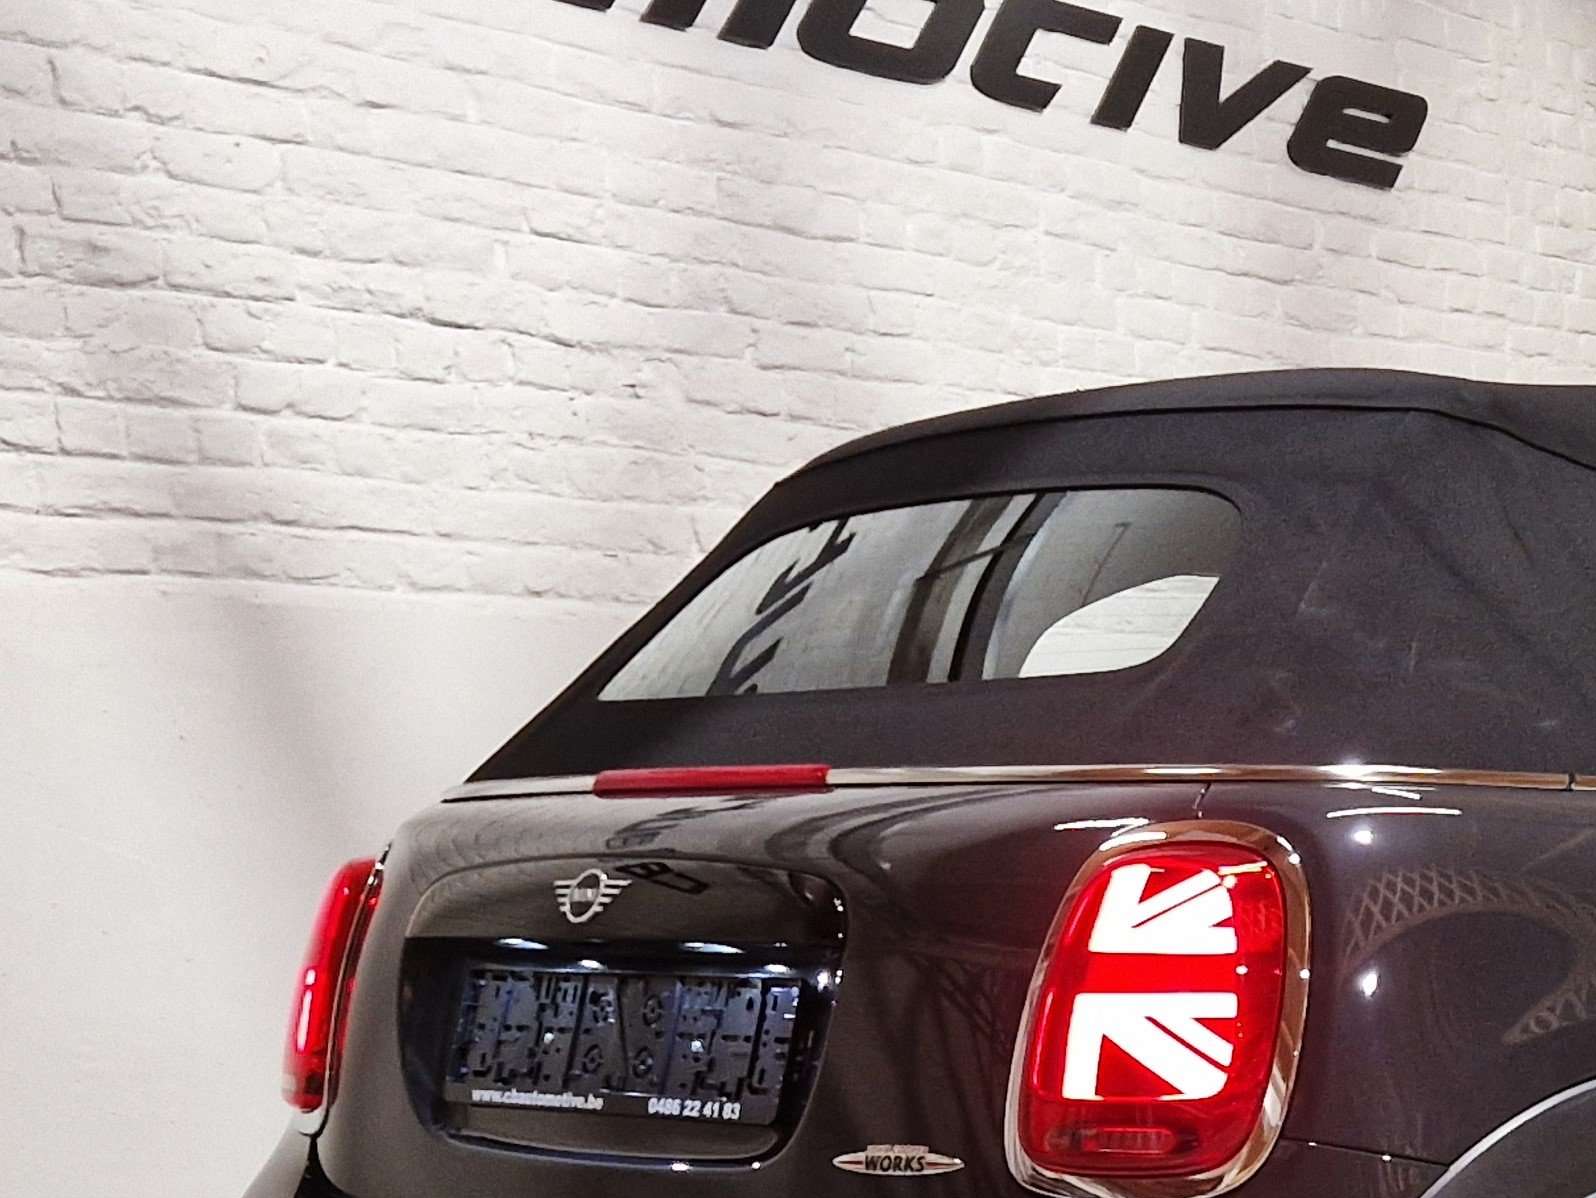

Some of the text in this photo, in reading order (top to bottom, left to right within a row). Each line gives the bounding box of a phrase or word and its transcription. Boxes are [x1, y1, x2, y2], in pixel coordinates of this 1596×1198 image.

[682, 1099, 701, 1118] 22
[702, 1101, 720, 1119] 41
[864, 1155, 926, 1173] WORKS
